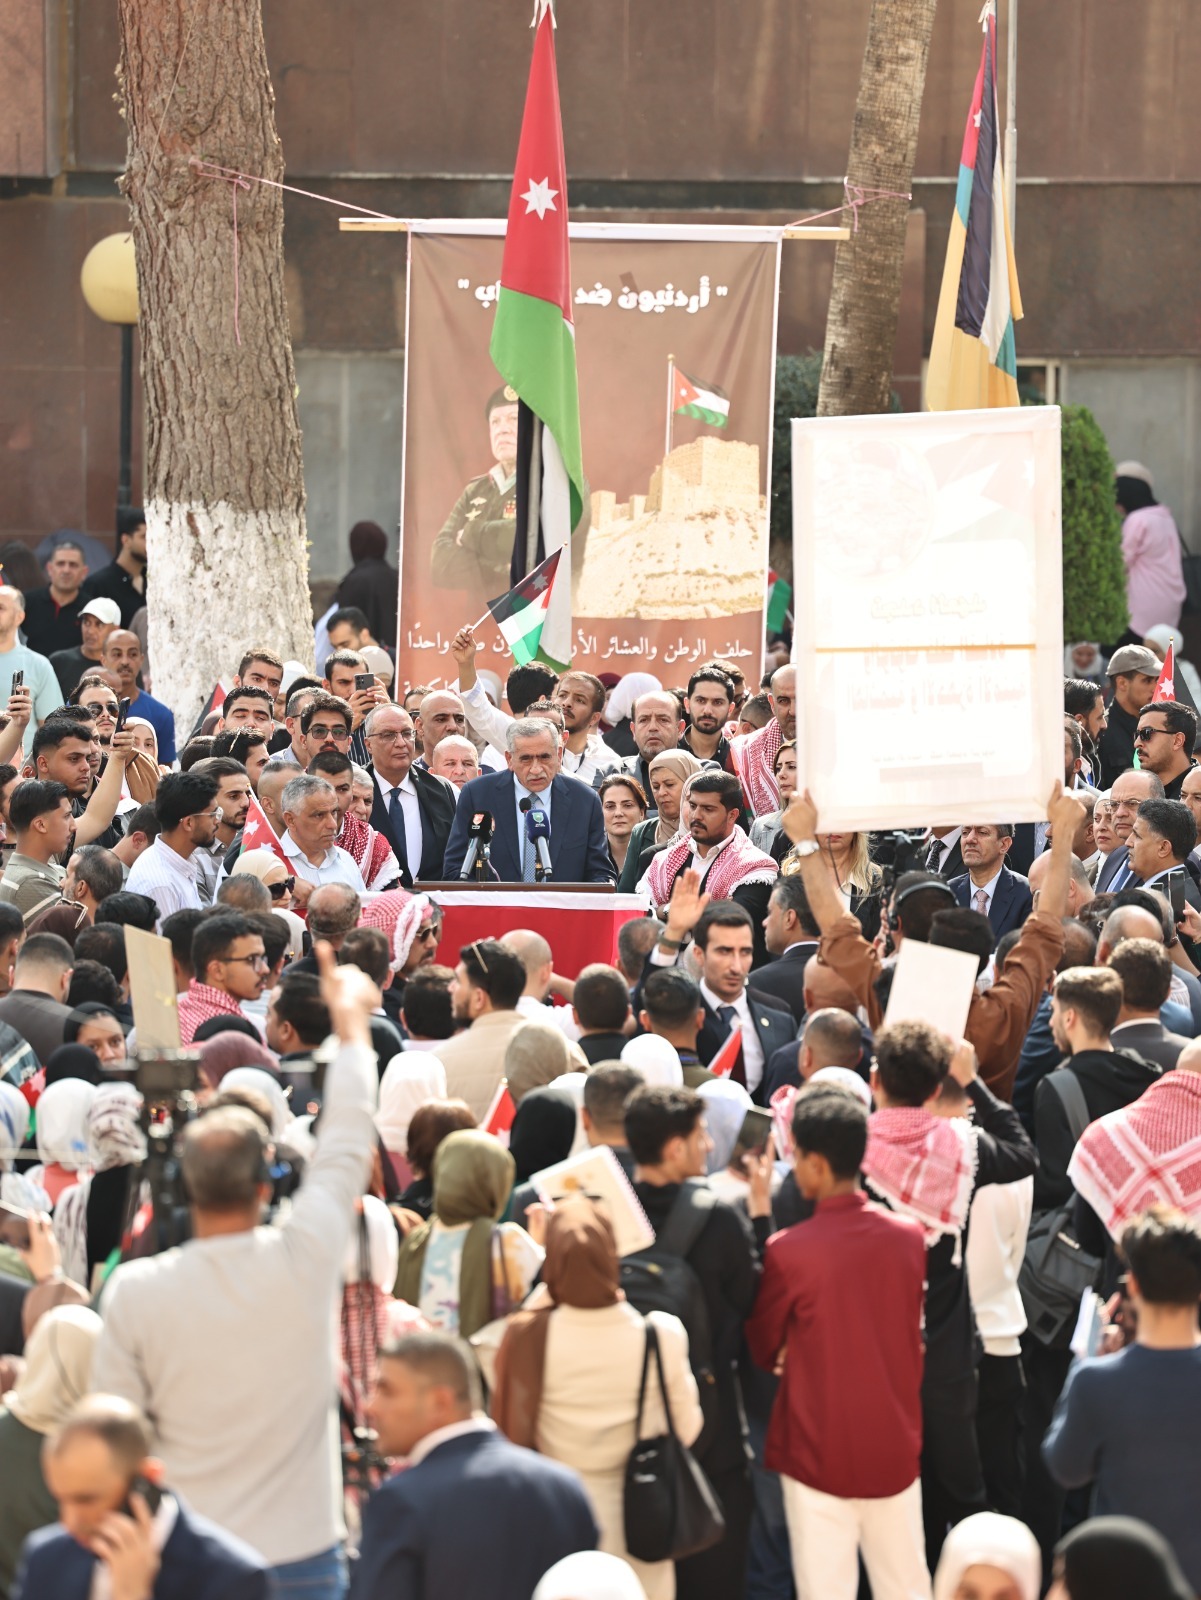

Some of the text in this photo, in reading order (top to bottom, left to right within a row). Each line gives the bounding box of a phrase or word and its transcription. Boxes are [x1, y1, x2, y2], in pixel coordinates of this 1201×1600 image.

[574, 282, 612, 307] ضد
[618, 275, 710, 313] أردنيون
[600, 635, 658, 660] والعشائر
[663, 637, 707, 663] الوطن
[713, 639, 753, 659] حلف
